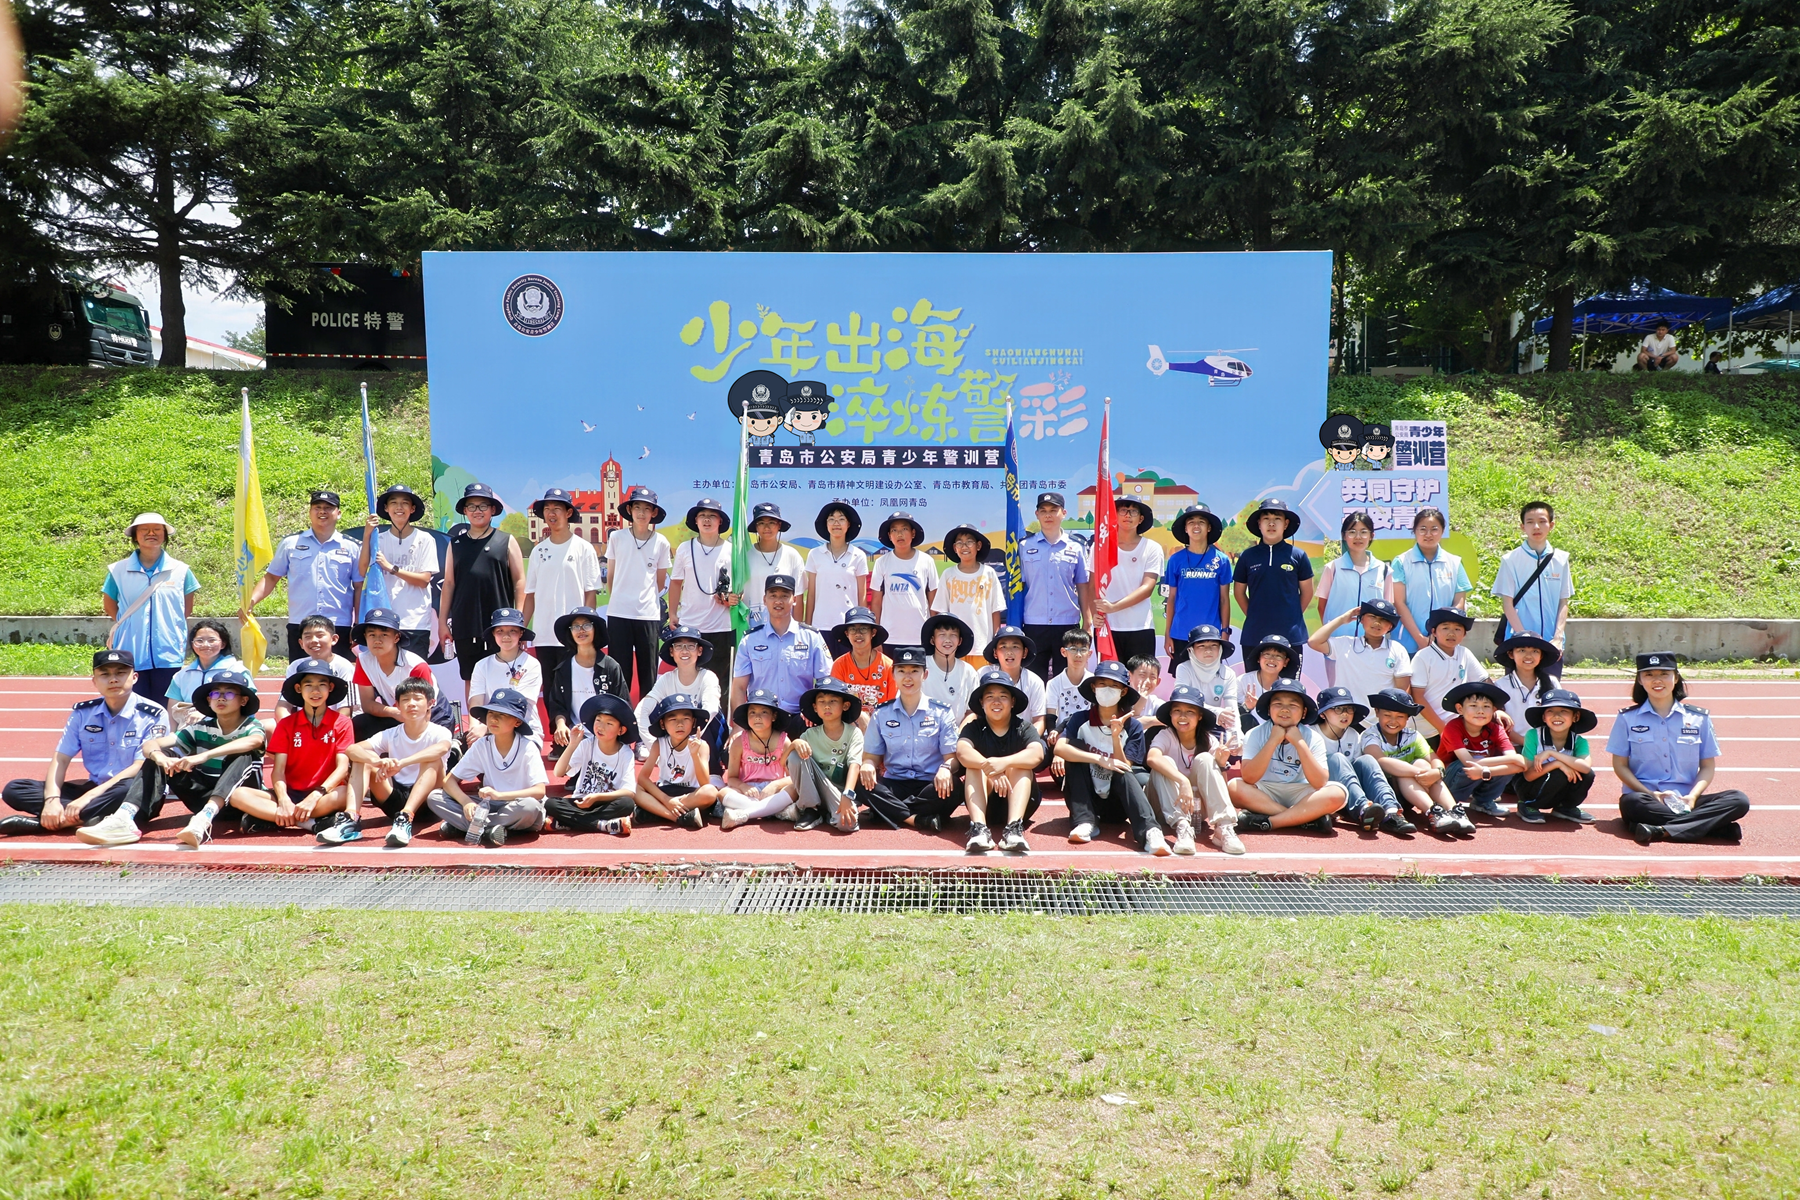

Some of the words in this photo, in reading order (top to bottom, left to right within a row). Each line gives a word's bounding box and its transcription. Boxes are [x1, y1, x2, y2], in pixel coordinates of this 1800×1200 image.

[311, 312, 359, 328] POLICE
[363, 311, 405, 331] 特警
[679, 299, 975, 383] 少年出海
[825, 370, 1089, 445] 淬炼警彩
[1409, 425, 1444, 438] 青少年
[758, 449, 1000, 466] 青岛市公安局青少年警训营
[1395, 440, 1446, 467] 警训营
[1341, 477, 1441, 503] 共同守护
[889, 582, 910, 592] ANTA
[293, 738, 302, 748] 23
